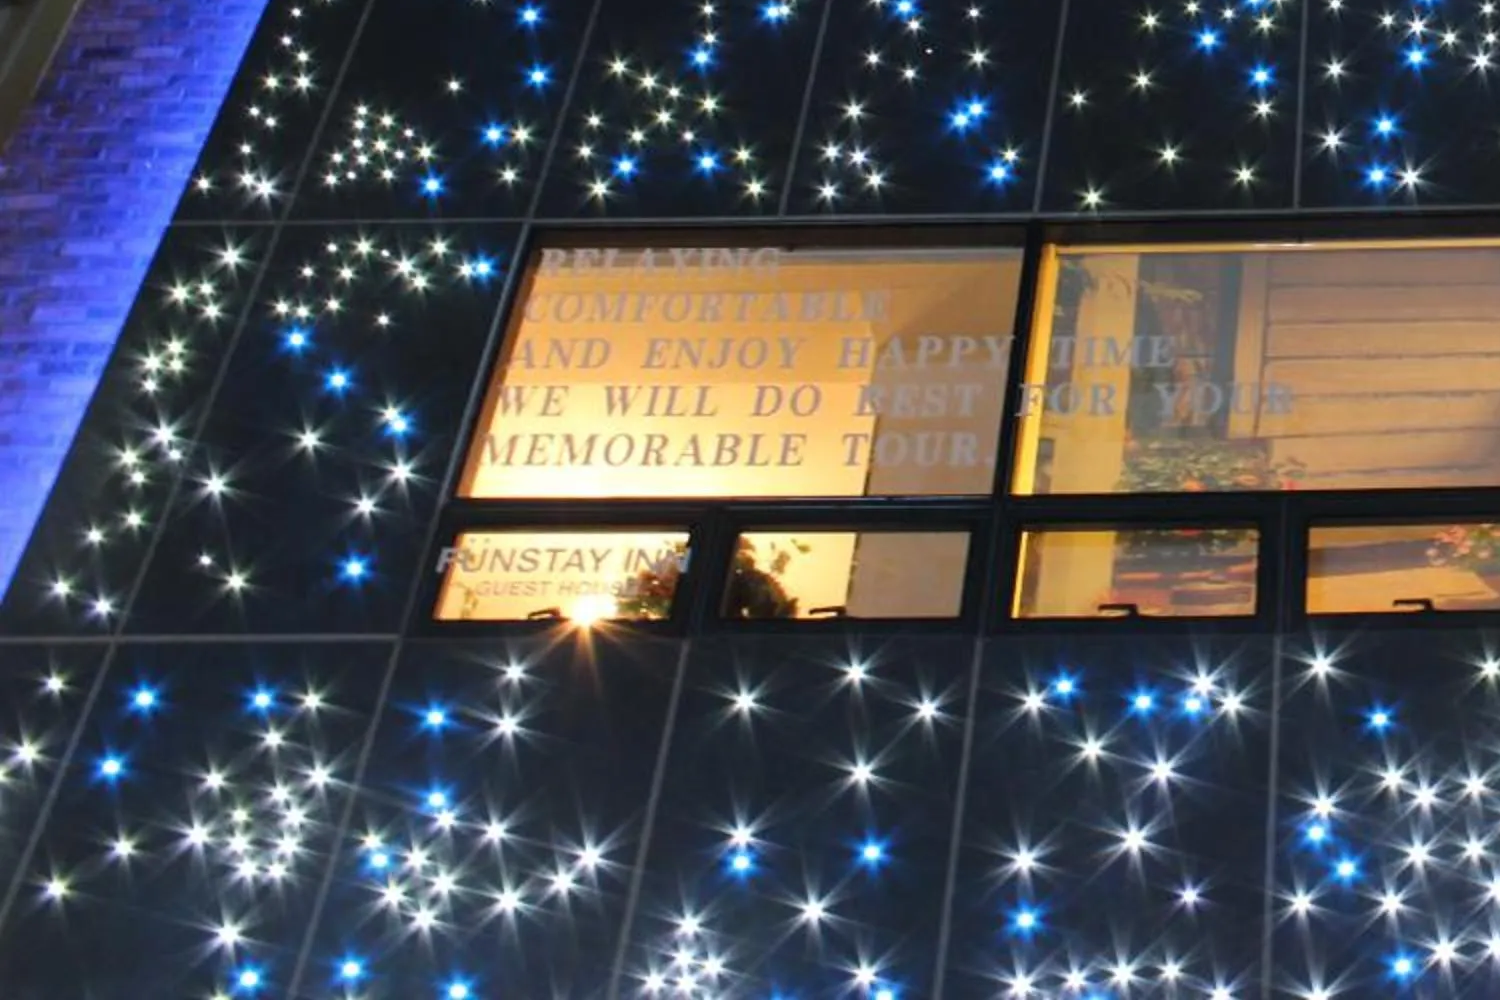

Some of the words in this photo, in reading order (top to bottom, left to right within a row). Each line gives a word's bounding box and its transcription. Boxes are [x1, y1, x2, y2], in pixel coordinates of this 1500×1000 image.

[540, 247, 781, 278] RELAXING
[524, 289, 892, 324] COMFORTABLE
[510, 337, 611, 370] AND
[641, 337, 808, 370] ENJOY
[837, 335, 1016, 370] HAPPY
[1052, 336, 1178, 369] TIME
[497, 384, 570, 418] WE
[604, 384, 719, 417] WILL
[750, 384, 823, 417] DO
[1013, 383, 1118, 417] FOR
[1153, 382, 1295, 416] YOUR
[480, 433, 807, 467] MEMORABLE
[841, 432, 994, 468] TOUR.
[622, 547, 691, 574] INN
[475, 579, 552, 597] GUEST
